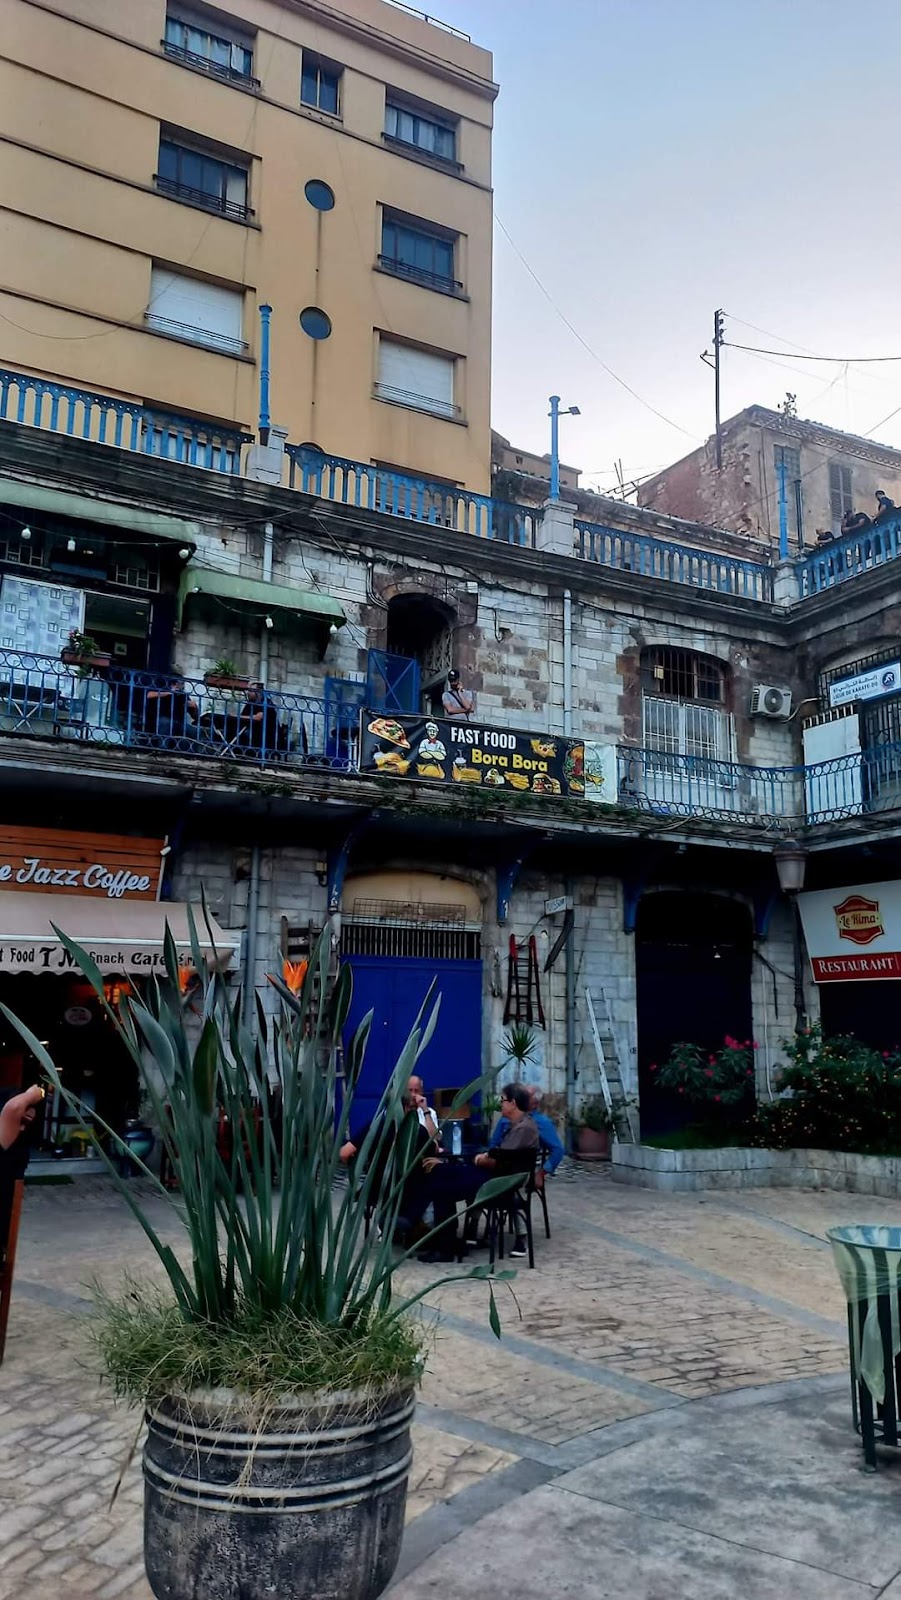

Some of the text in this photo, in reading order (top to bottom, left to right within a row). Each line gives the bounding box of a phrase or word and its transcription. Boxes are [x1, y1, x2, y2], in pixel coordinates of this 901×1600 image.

[450, 726, 517, 750] FAST FOOD
[471, 748, 548, 772] Bora Bora
[16, 858, 80, 887] Jazz
[83, 864, 150, 897] Coffee
[841, 915, 851, 928] Le
[10, 947, 35, 962] Food
[89, 951, 124, 965] Snack
